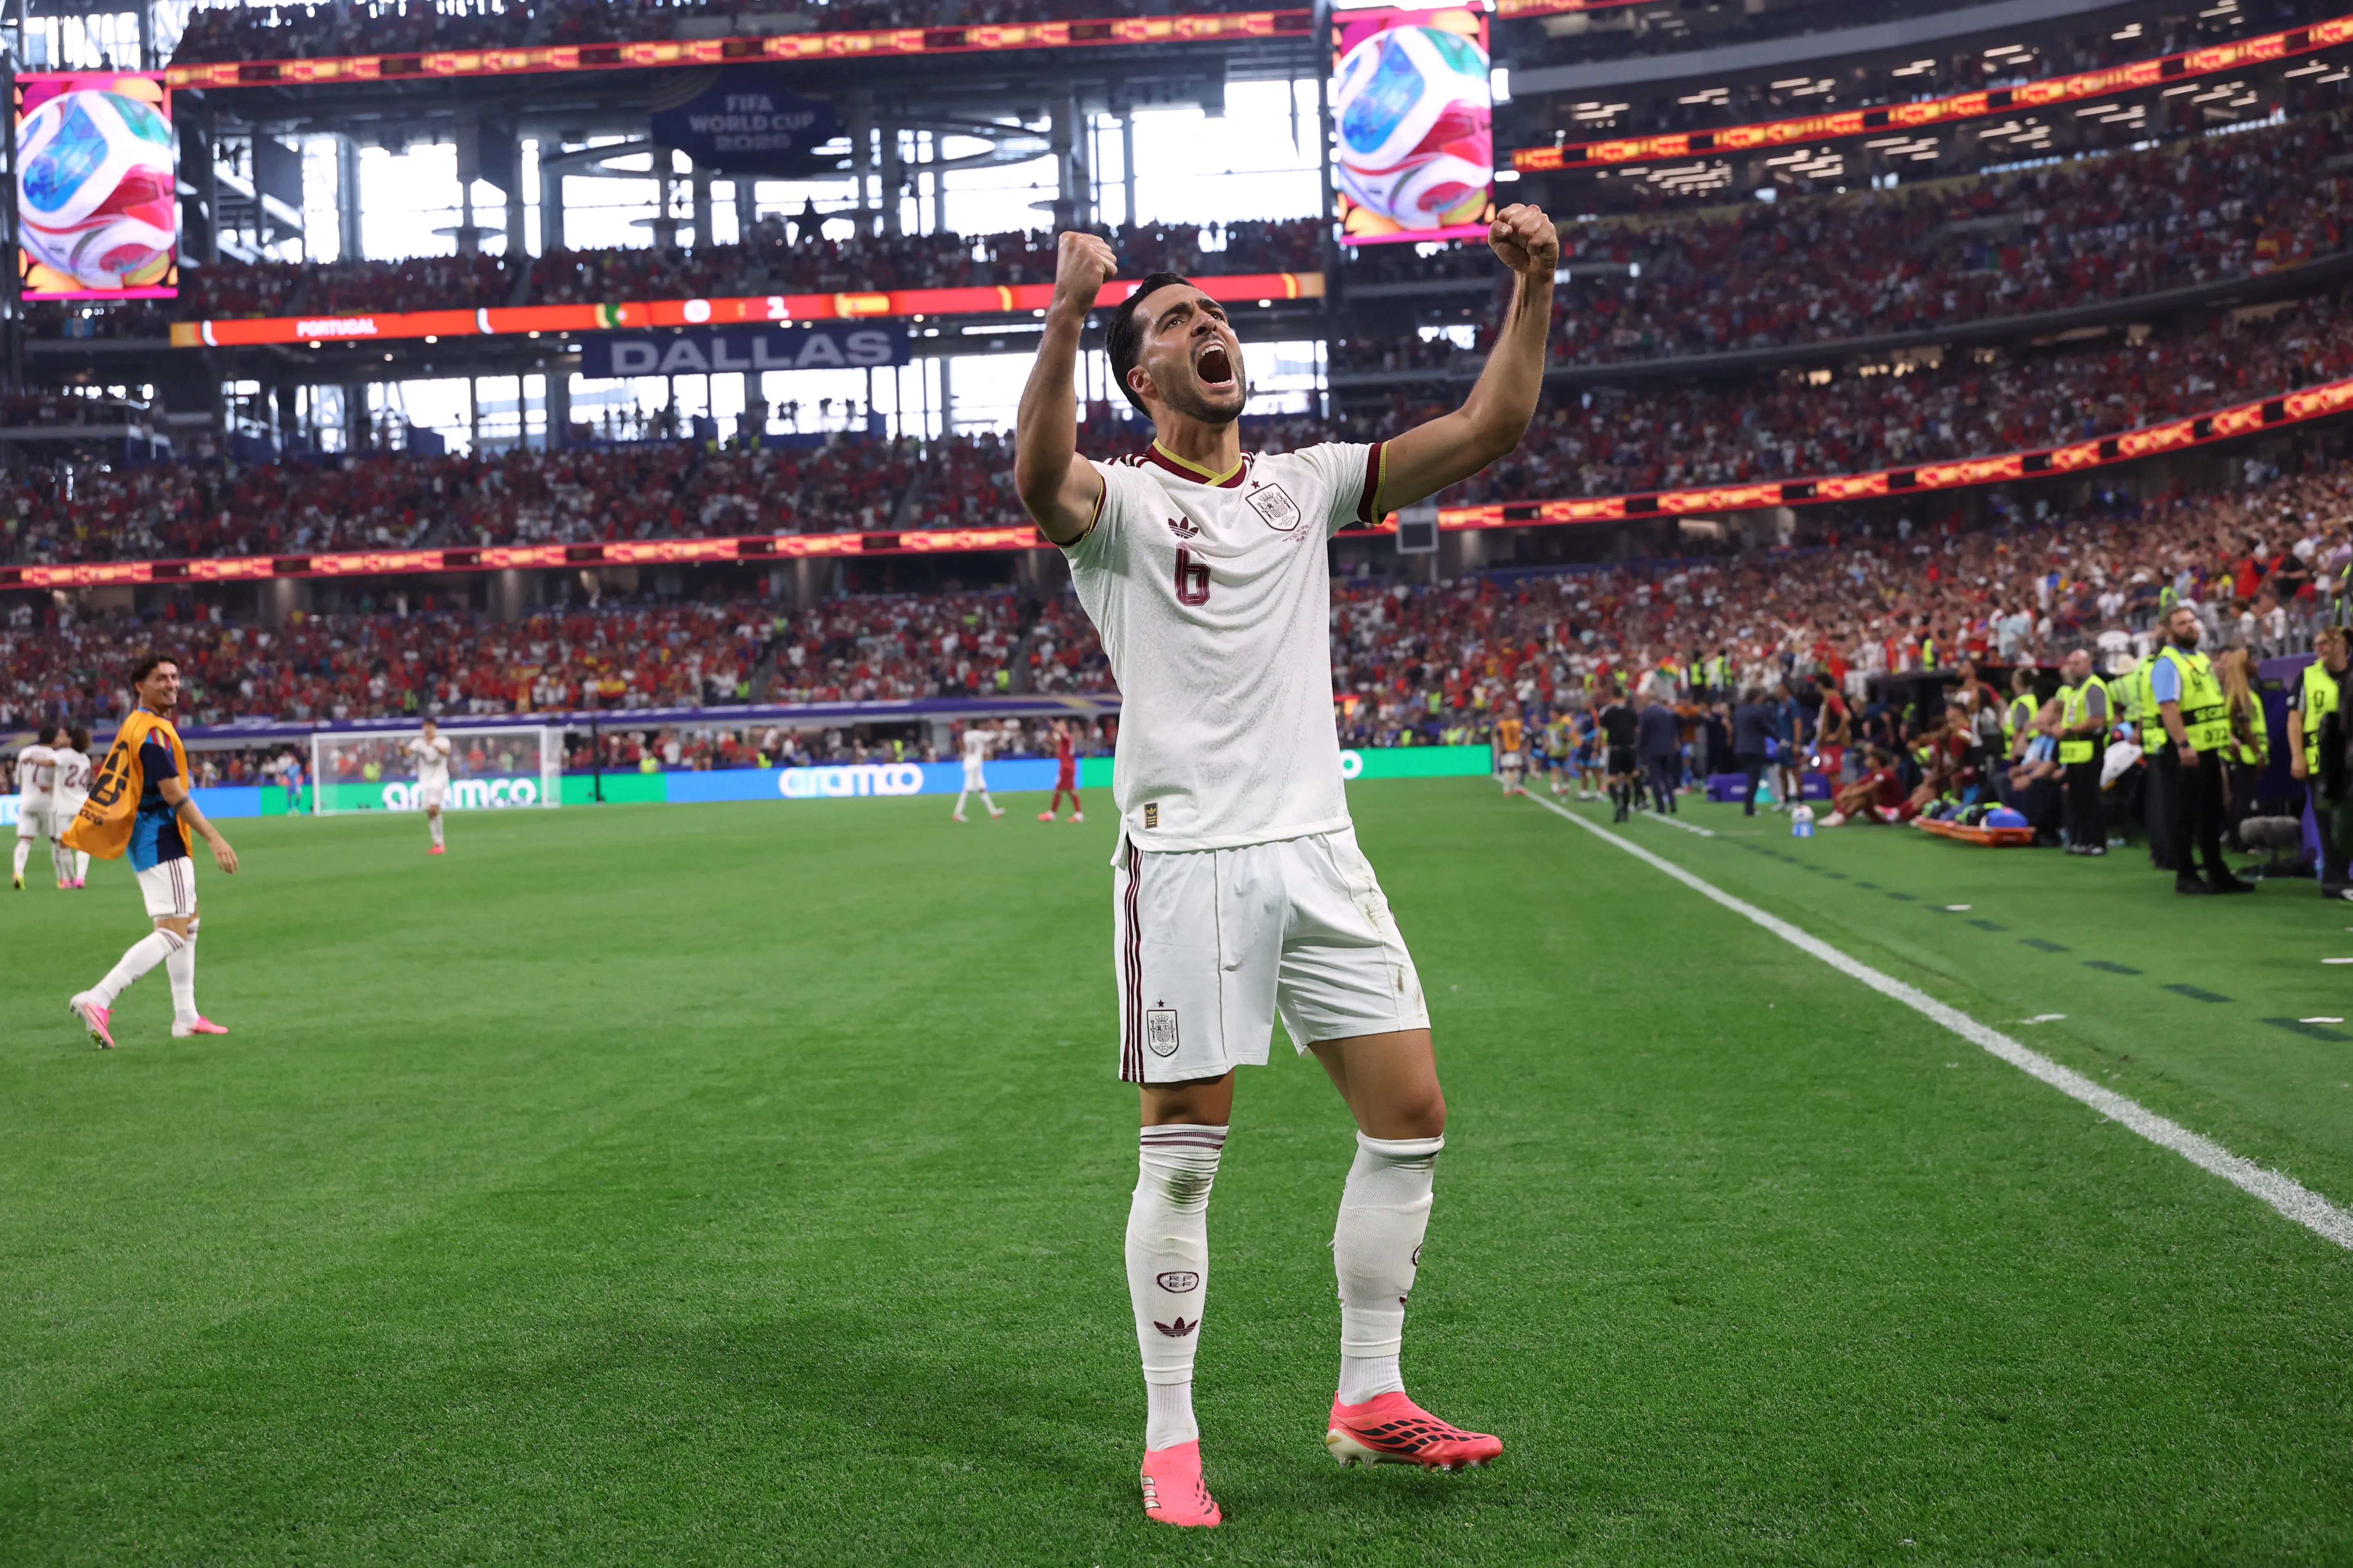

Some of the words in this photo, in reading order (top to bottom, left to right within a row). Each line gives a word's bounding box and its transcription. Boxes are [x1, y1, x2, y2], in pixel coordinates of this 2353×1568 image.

[726, 94, 773, 112] FIFA
[689, 114, 769, 133] WORLD
[771, 112, 815, 131] CUP
[766, 296, 790, 319] 1
[296, 318, 378, 337] PORTUGAL
[610, 331, 892, 375] DALLAS
[1174, 541, 1211, 606] 6
[778, 762, 924, 798] aramco
[382, 778, 537, 811] armco
